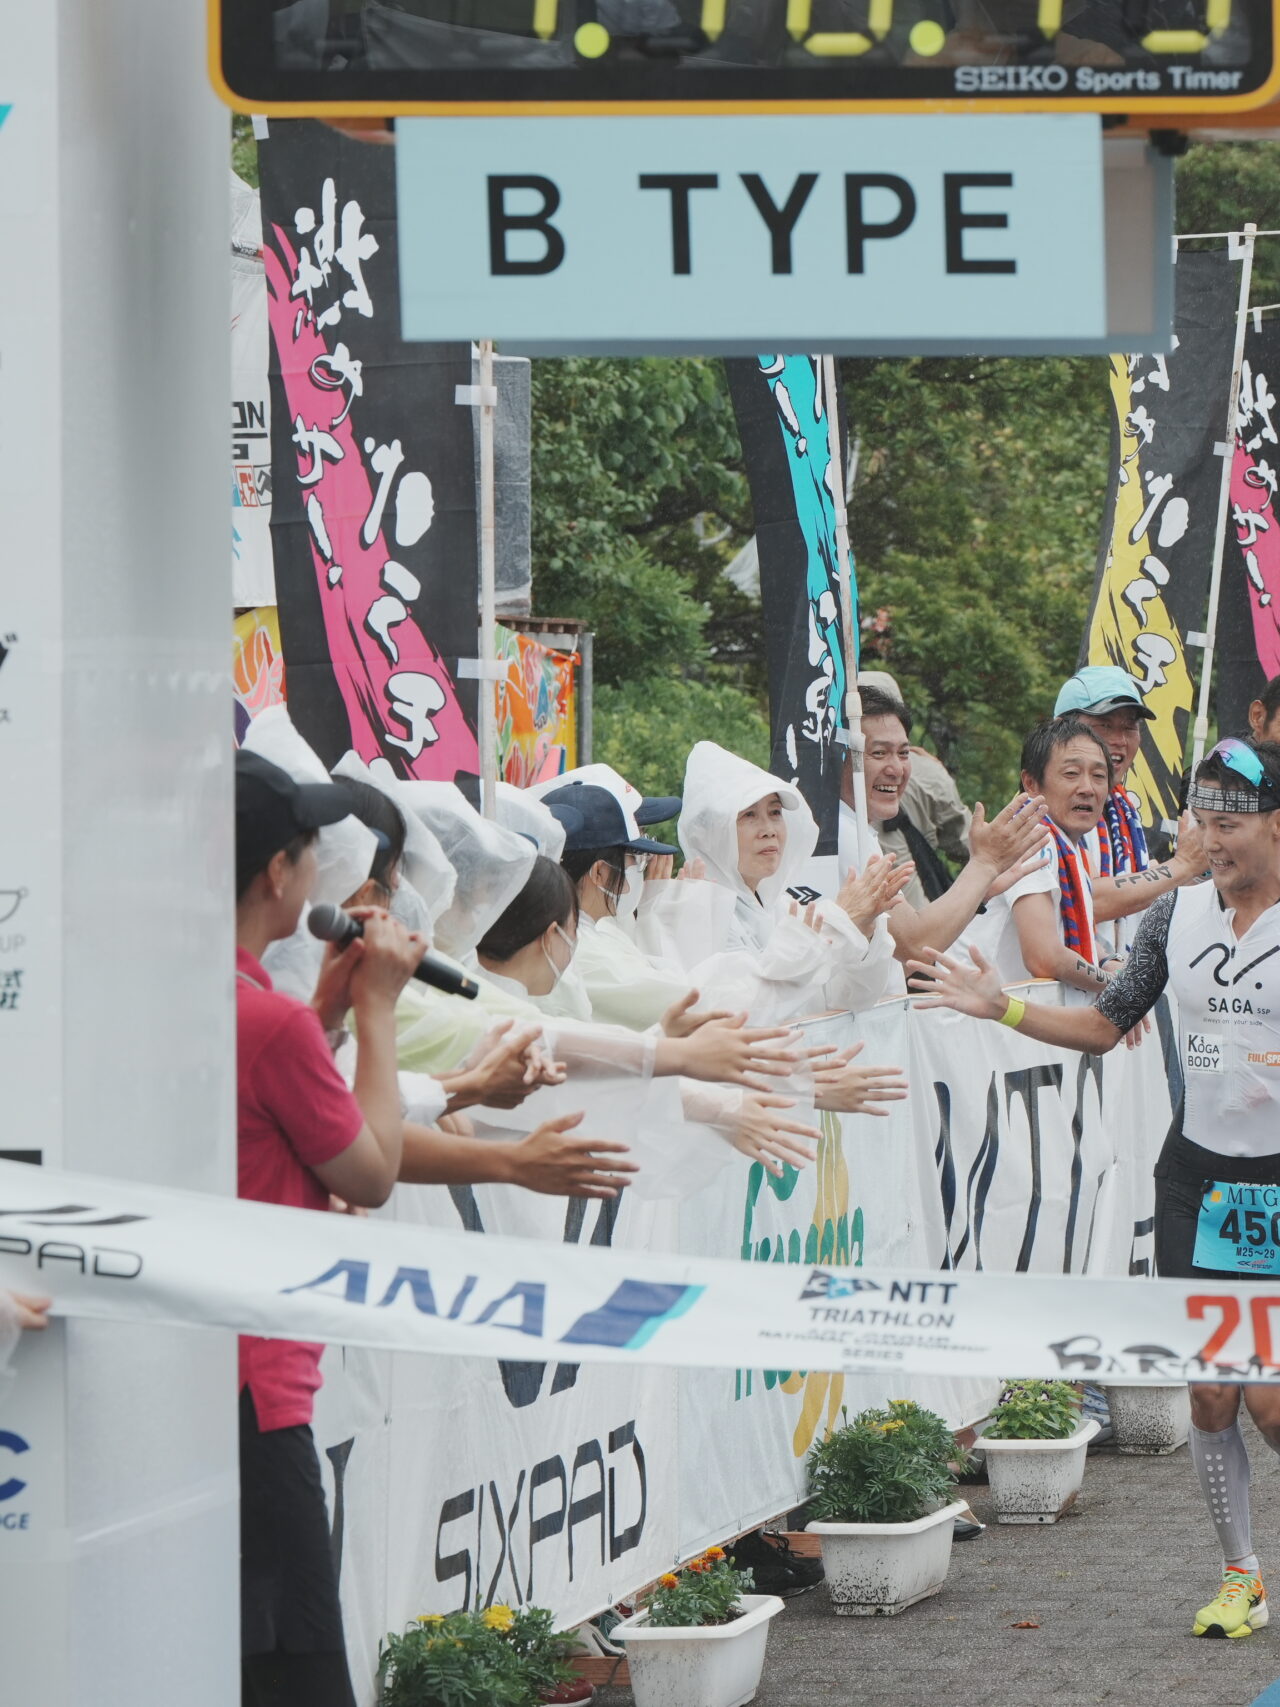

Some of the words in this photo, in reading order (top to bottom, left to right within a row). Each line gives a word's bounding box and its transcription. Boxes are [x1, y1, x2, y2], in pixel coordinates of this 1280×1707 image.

[955, 66, 1068, 91] SEIKO
[1075, 67, 1161, 93] Sports
[1168, 66, 1243, 90] Timer
[487, 174, 566, 276] B
[638, 172, 1018, 275] TYPE
[1207, 997, 1254, 1015] SAGA
[1188, 1034, 1220, 1055] KOGA
[1187, 1055, 1220, 1069] BODY
[1227, 1185, 1278, 1208] MTG
[280, 1258, 547, 1338] ANA
[889, 1281, 958, 1304] NTT
[808, 1306, 955, 1329] TRIATHLON
[435, 1419, 647, 1613] SIXPAD
